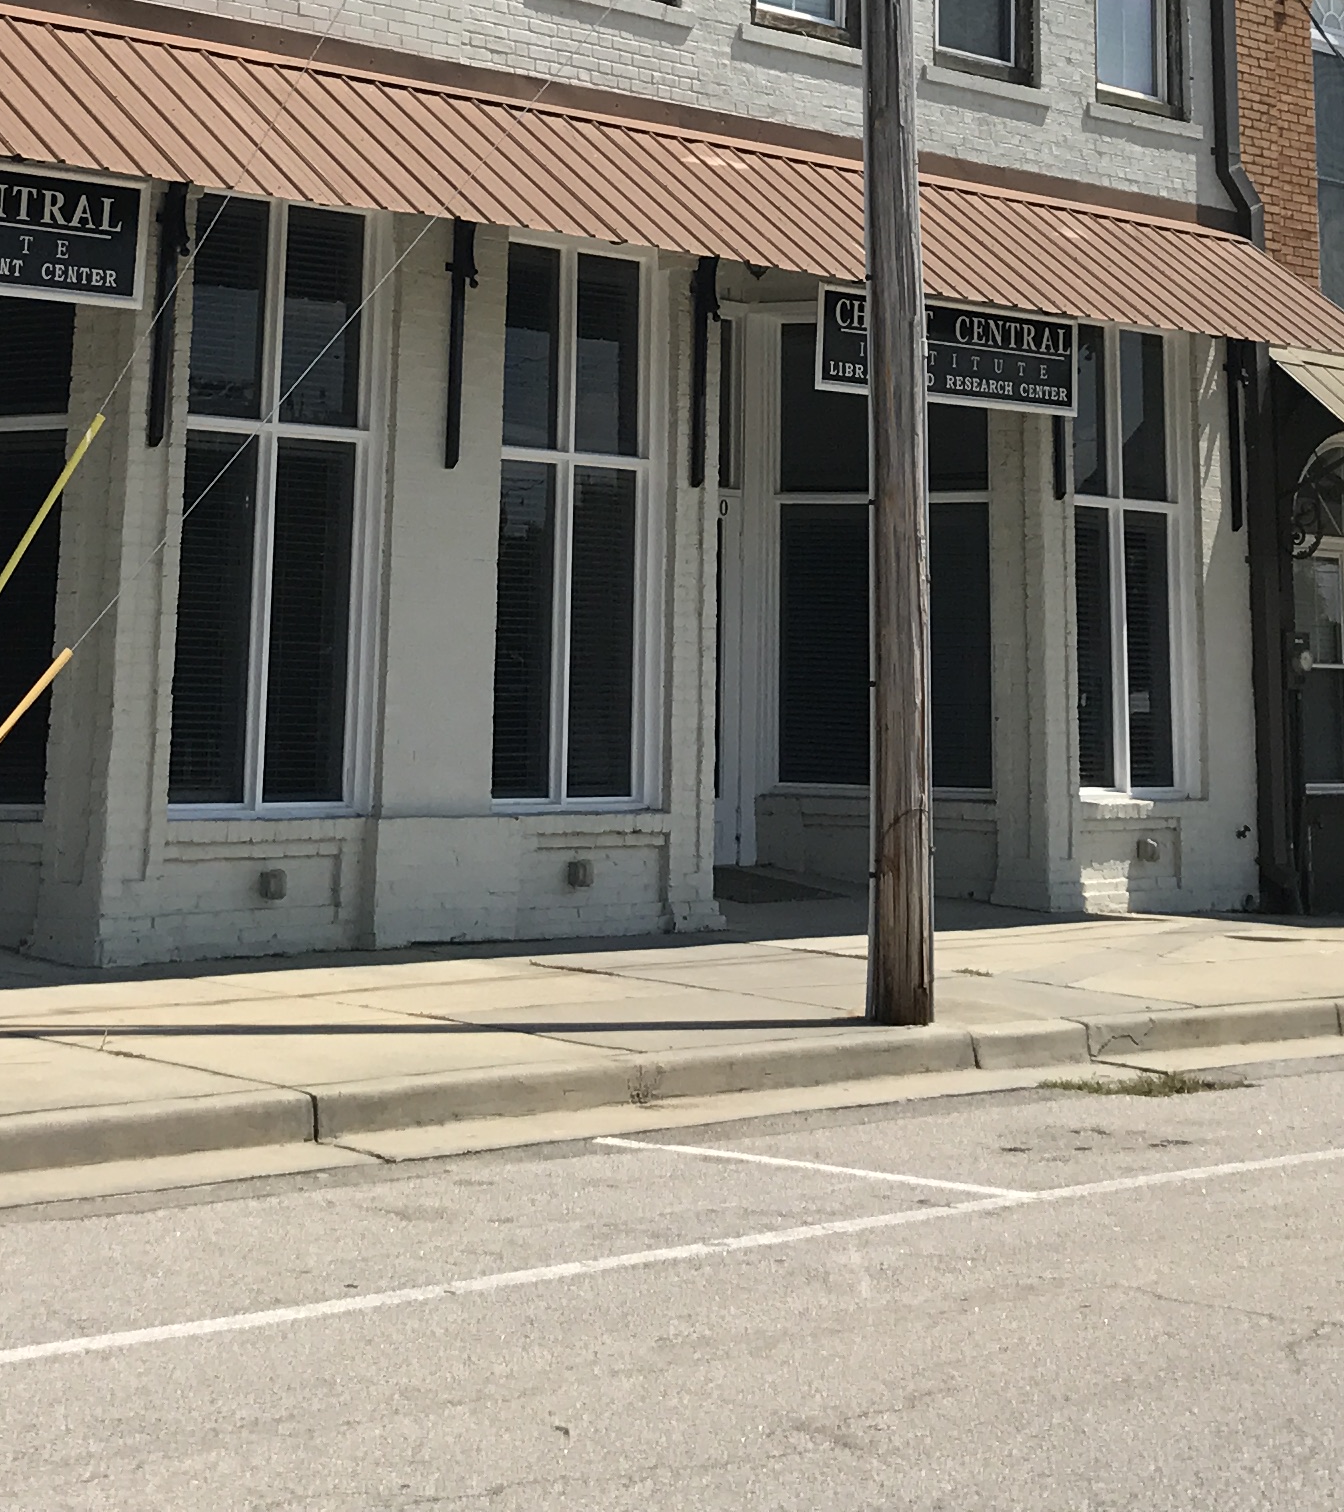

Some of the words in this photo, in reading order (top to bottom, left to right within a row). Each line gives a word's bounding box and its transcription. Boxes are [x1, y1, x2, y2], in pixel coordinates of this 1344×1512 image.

[41, 262, 118, 288] CENTER
[955, 315, 1071, 355] CENTRAL
[859, 341, 1048, 380] ITITUTE
[946, 375, 1013, 396] RESEARCH
[1019, 382, 1069, 402] CENTER
